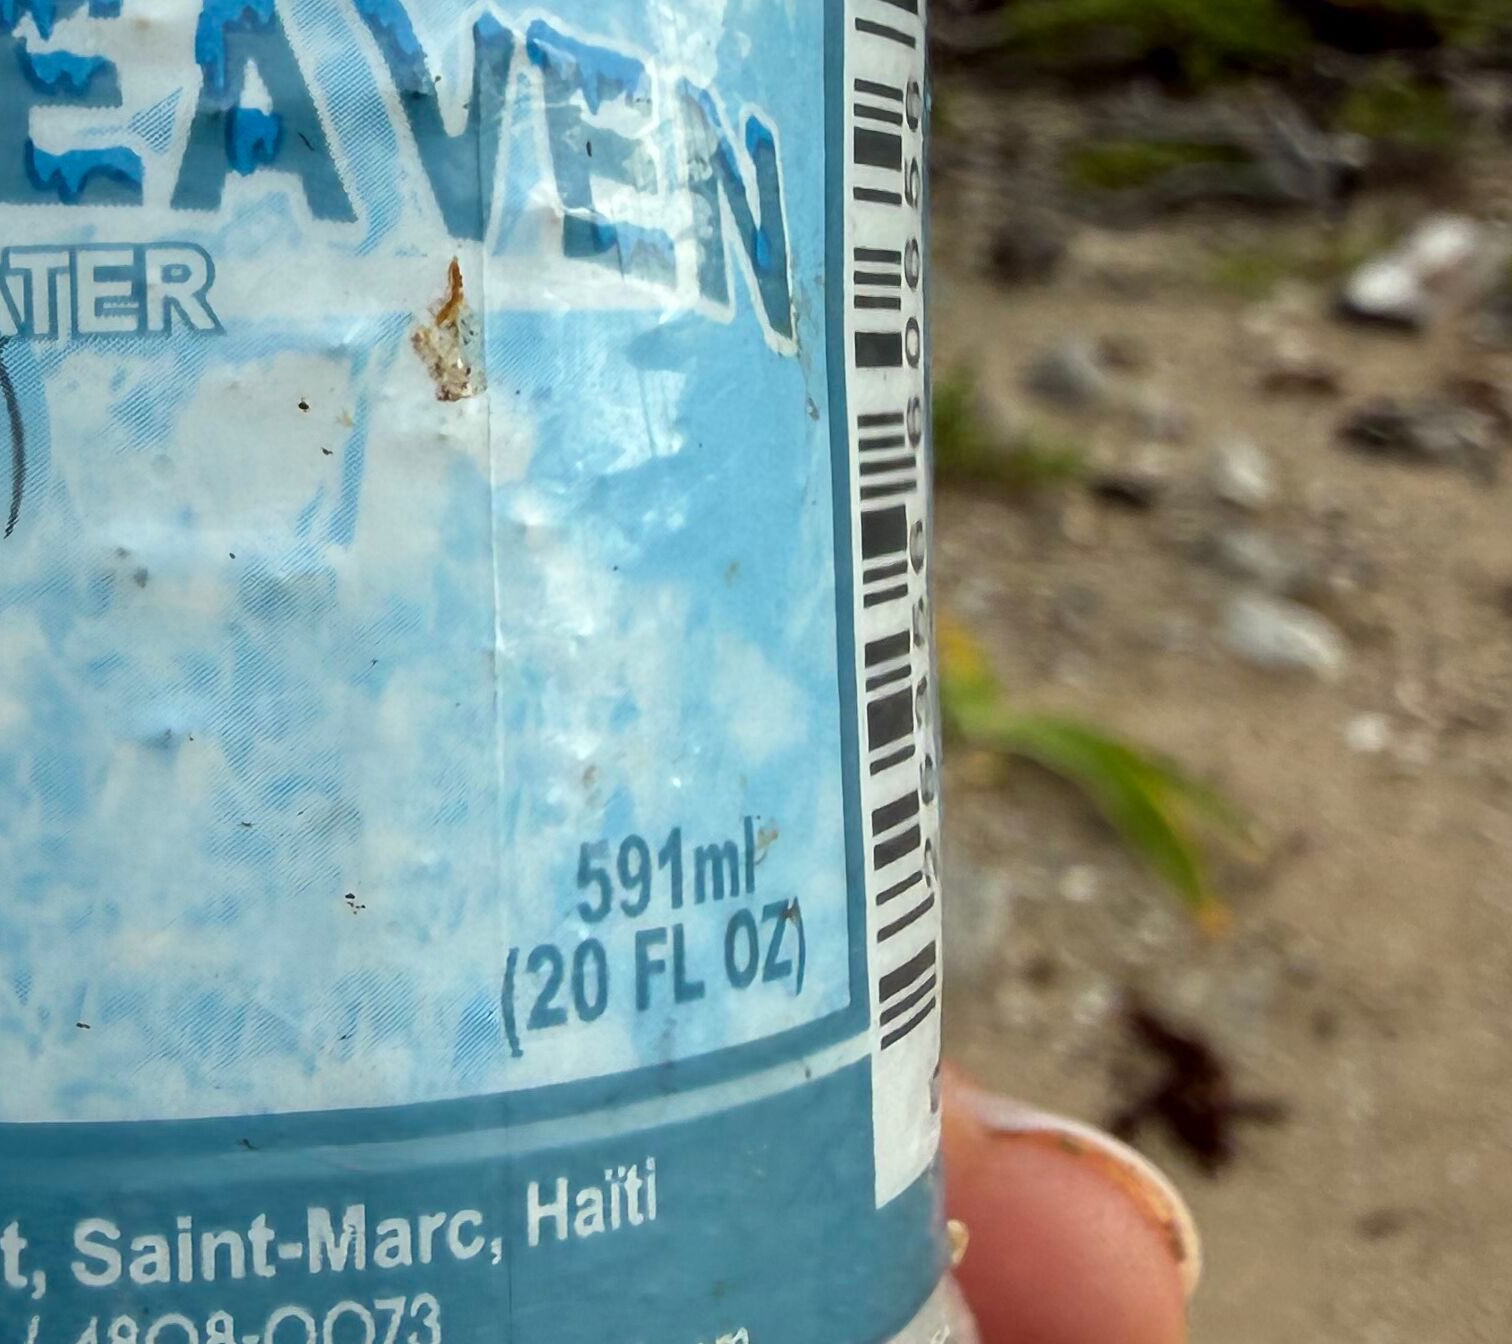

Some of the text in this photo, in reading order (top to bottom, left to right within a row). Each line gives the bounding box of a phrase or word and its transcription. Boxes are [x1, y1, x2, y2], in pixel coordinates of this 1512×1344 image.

[576, 815, 755, 923] 591ml
[501, 897, 807, 1057] (20 FL OZ)
[71, 1202, 504, 1288] Saint-Marc,
